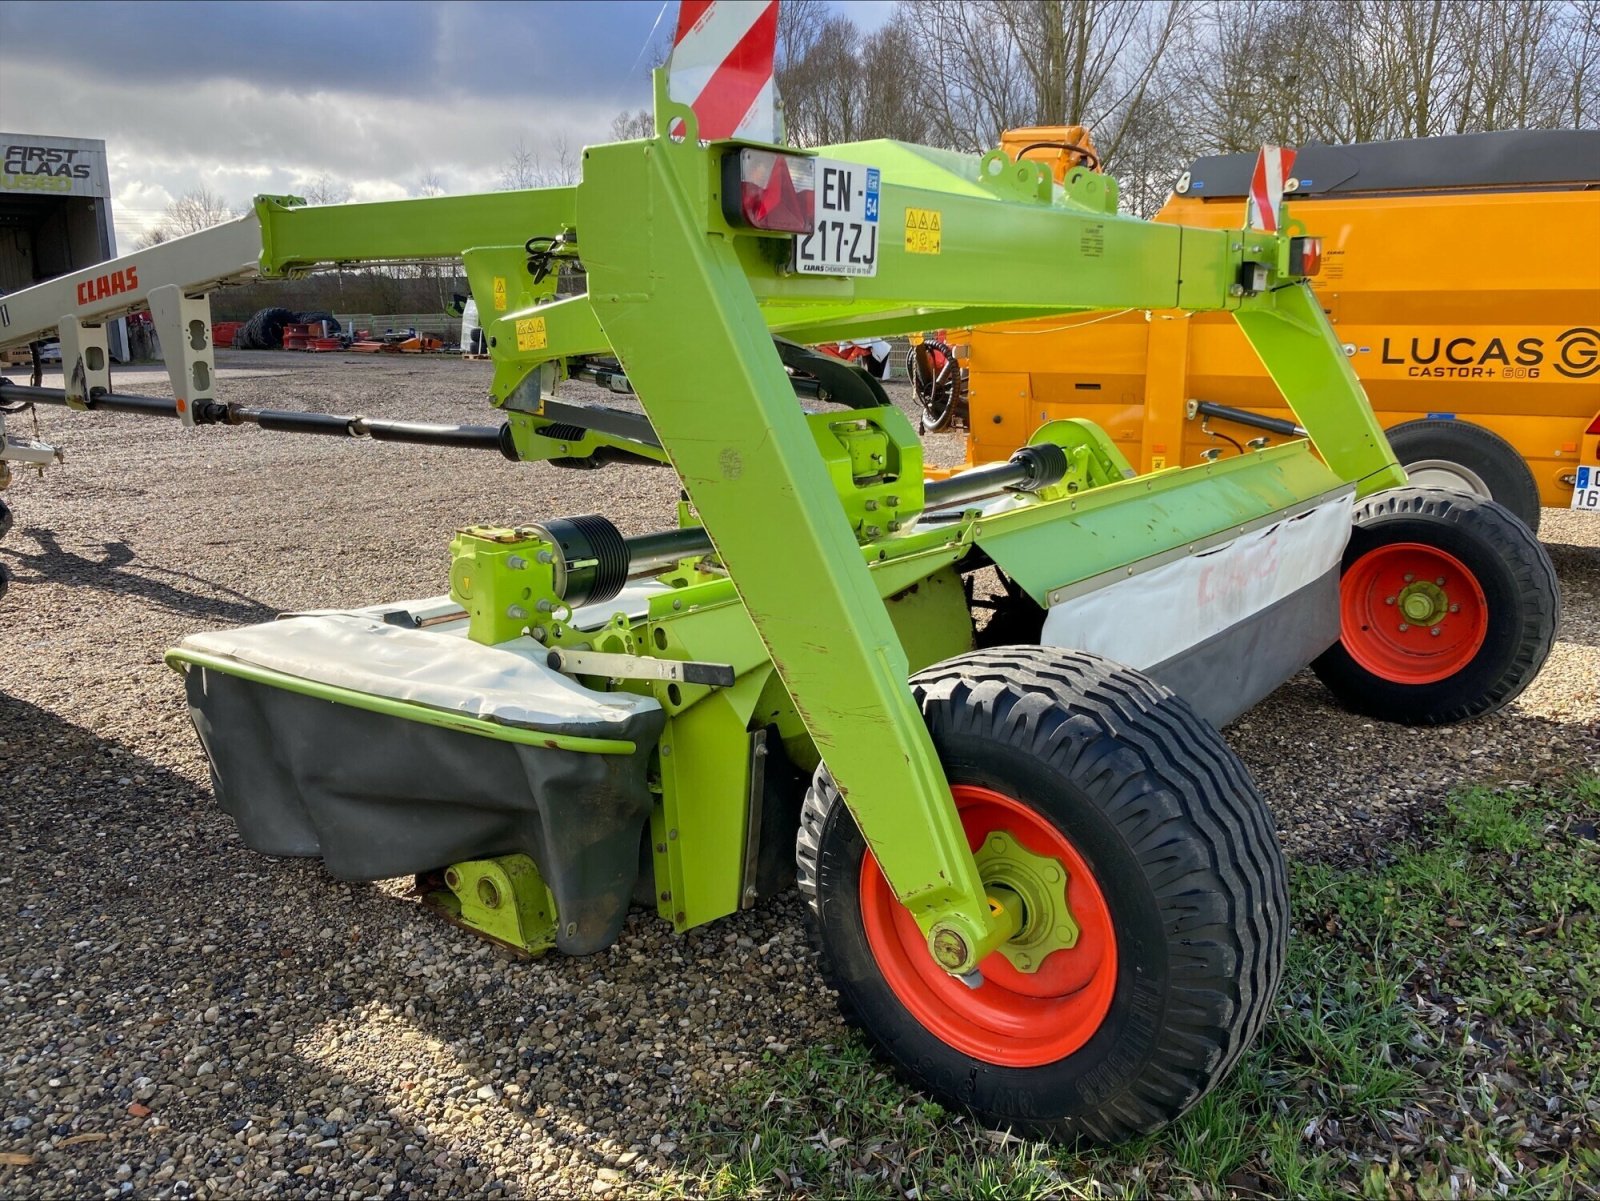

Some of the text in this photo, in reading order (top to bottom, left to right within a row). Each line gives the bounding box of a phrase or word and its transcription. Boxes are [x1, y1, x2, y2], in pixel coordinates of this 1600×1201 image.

[6, 145, 79, 163] FIRST
[4, 160, 91, 179] CLAAS
[866, 198, 877, 216] 54
[803, 264, 824, 272] CLAAS
[77, 266, 138, 306] CLAAS
[1382, 338, 1544, 366] LUCAS
[1408, 367, 1541, 379] CASTOR+ 60G
[1577, 489, 1599, 507] 16
